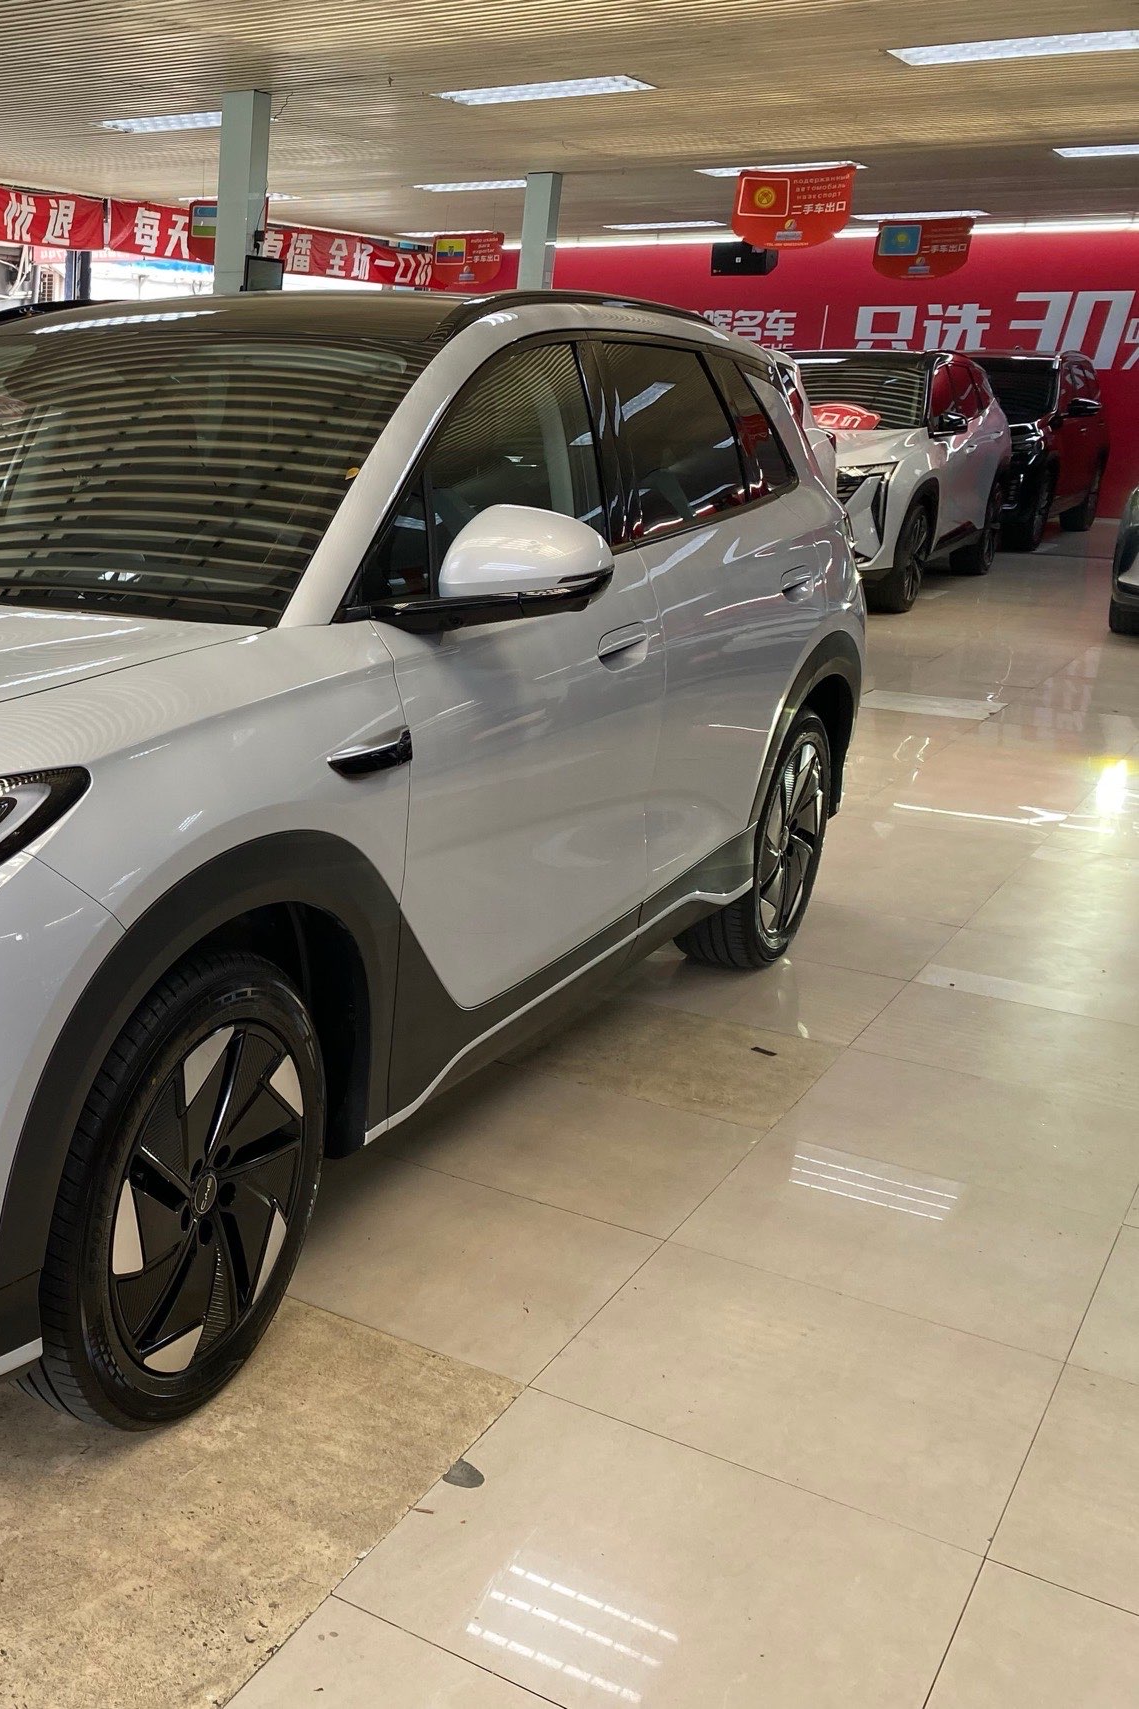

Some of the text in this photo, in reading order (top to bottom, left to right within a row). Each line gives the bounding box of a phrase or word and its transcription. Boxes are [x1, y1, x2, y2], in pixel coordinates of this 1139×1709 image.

[791, 201, 847, 215] 二手车出口
[920, 243, 968, 254] 二手车出口
[466, 254, 500, 263] 二手车出口
[692, 309, 797, 341] 晖名车
[813, 411, 862, 429] 口价
